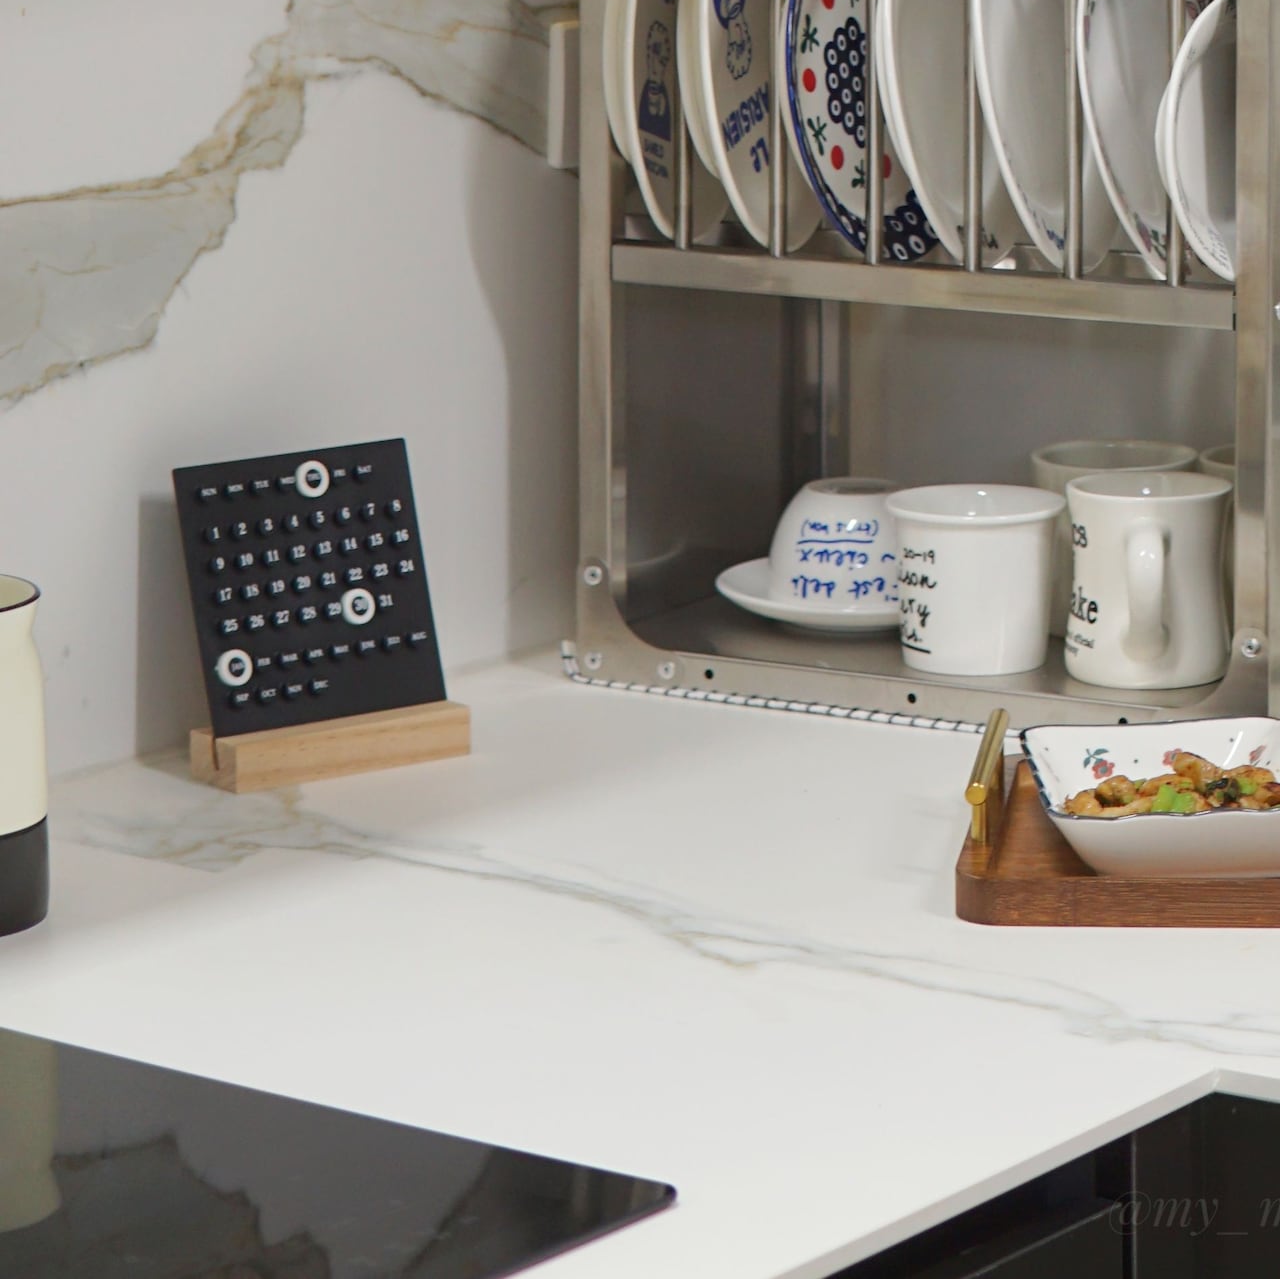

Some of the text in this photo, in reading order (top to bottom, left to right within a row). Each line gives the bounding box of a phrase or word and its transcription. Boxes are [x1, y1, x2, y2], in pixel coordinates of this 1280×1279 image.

[240, 552, 254, 567] 10
[266, 549, 280, 563] 11
[292, 544, 307, 559] 12
[318, 540, 333, 555] 13
[344, 537, 359, 551] 14
[370, 532, 384, 547] 15
[395, 528, 410, 543] 16
[219, 559, 415, 602] 17 18 19 20 21 22 23 24
[224, 618, 239, 633] 25
[249, 614, 265, 629] 26
[275, 609, 290, 624] 27
[301, 606, 317, 621] 28
[327, 601, 342, 616] 29
[379, 594, 394, 608] 31
